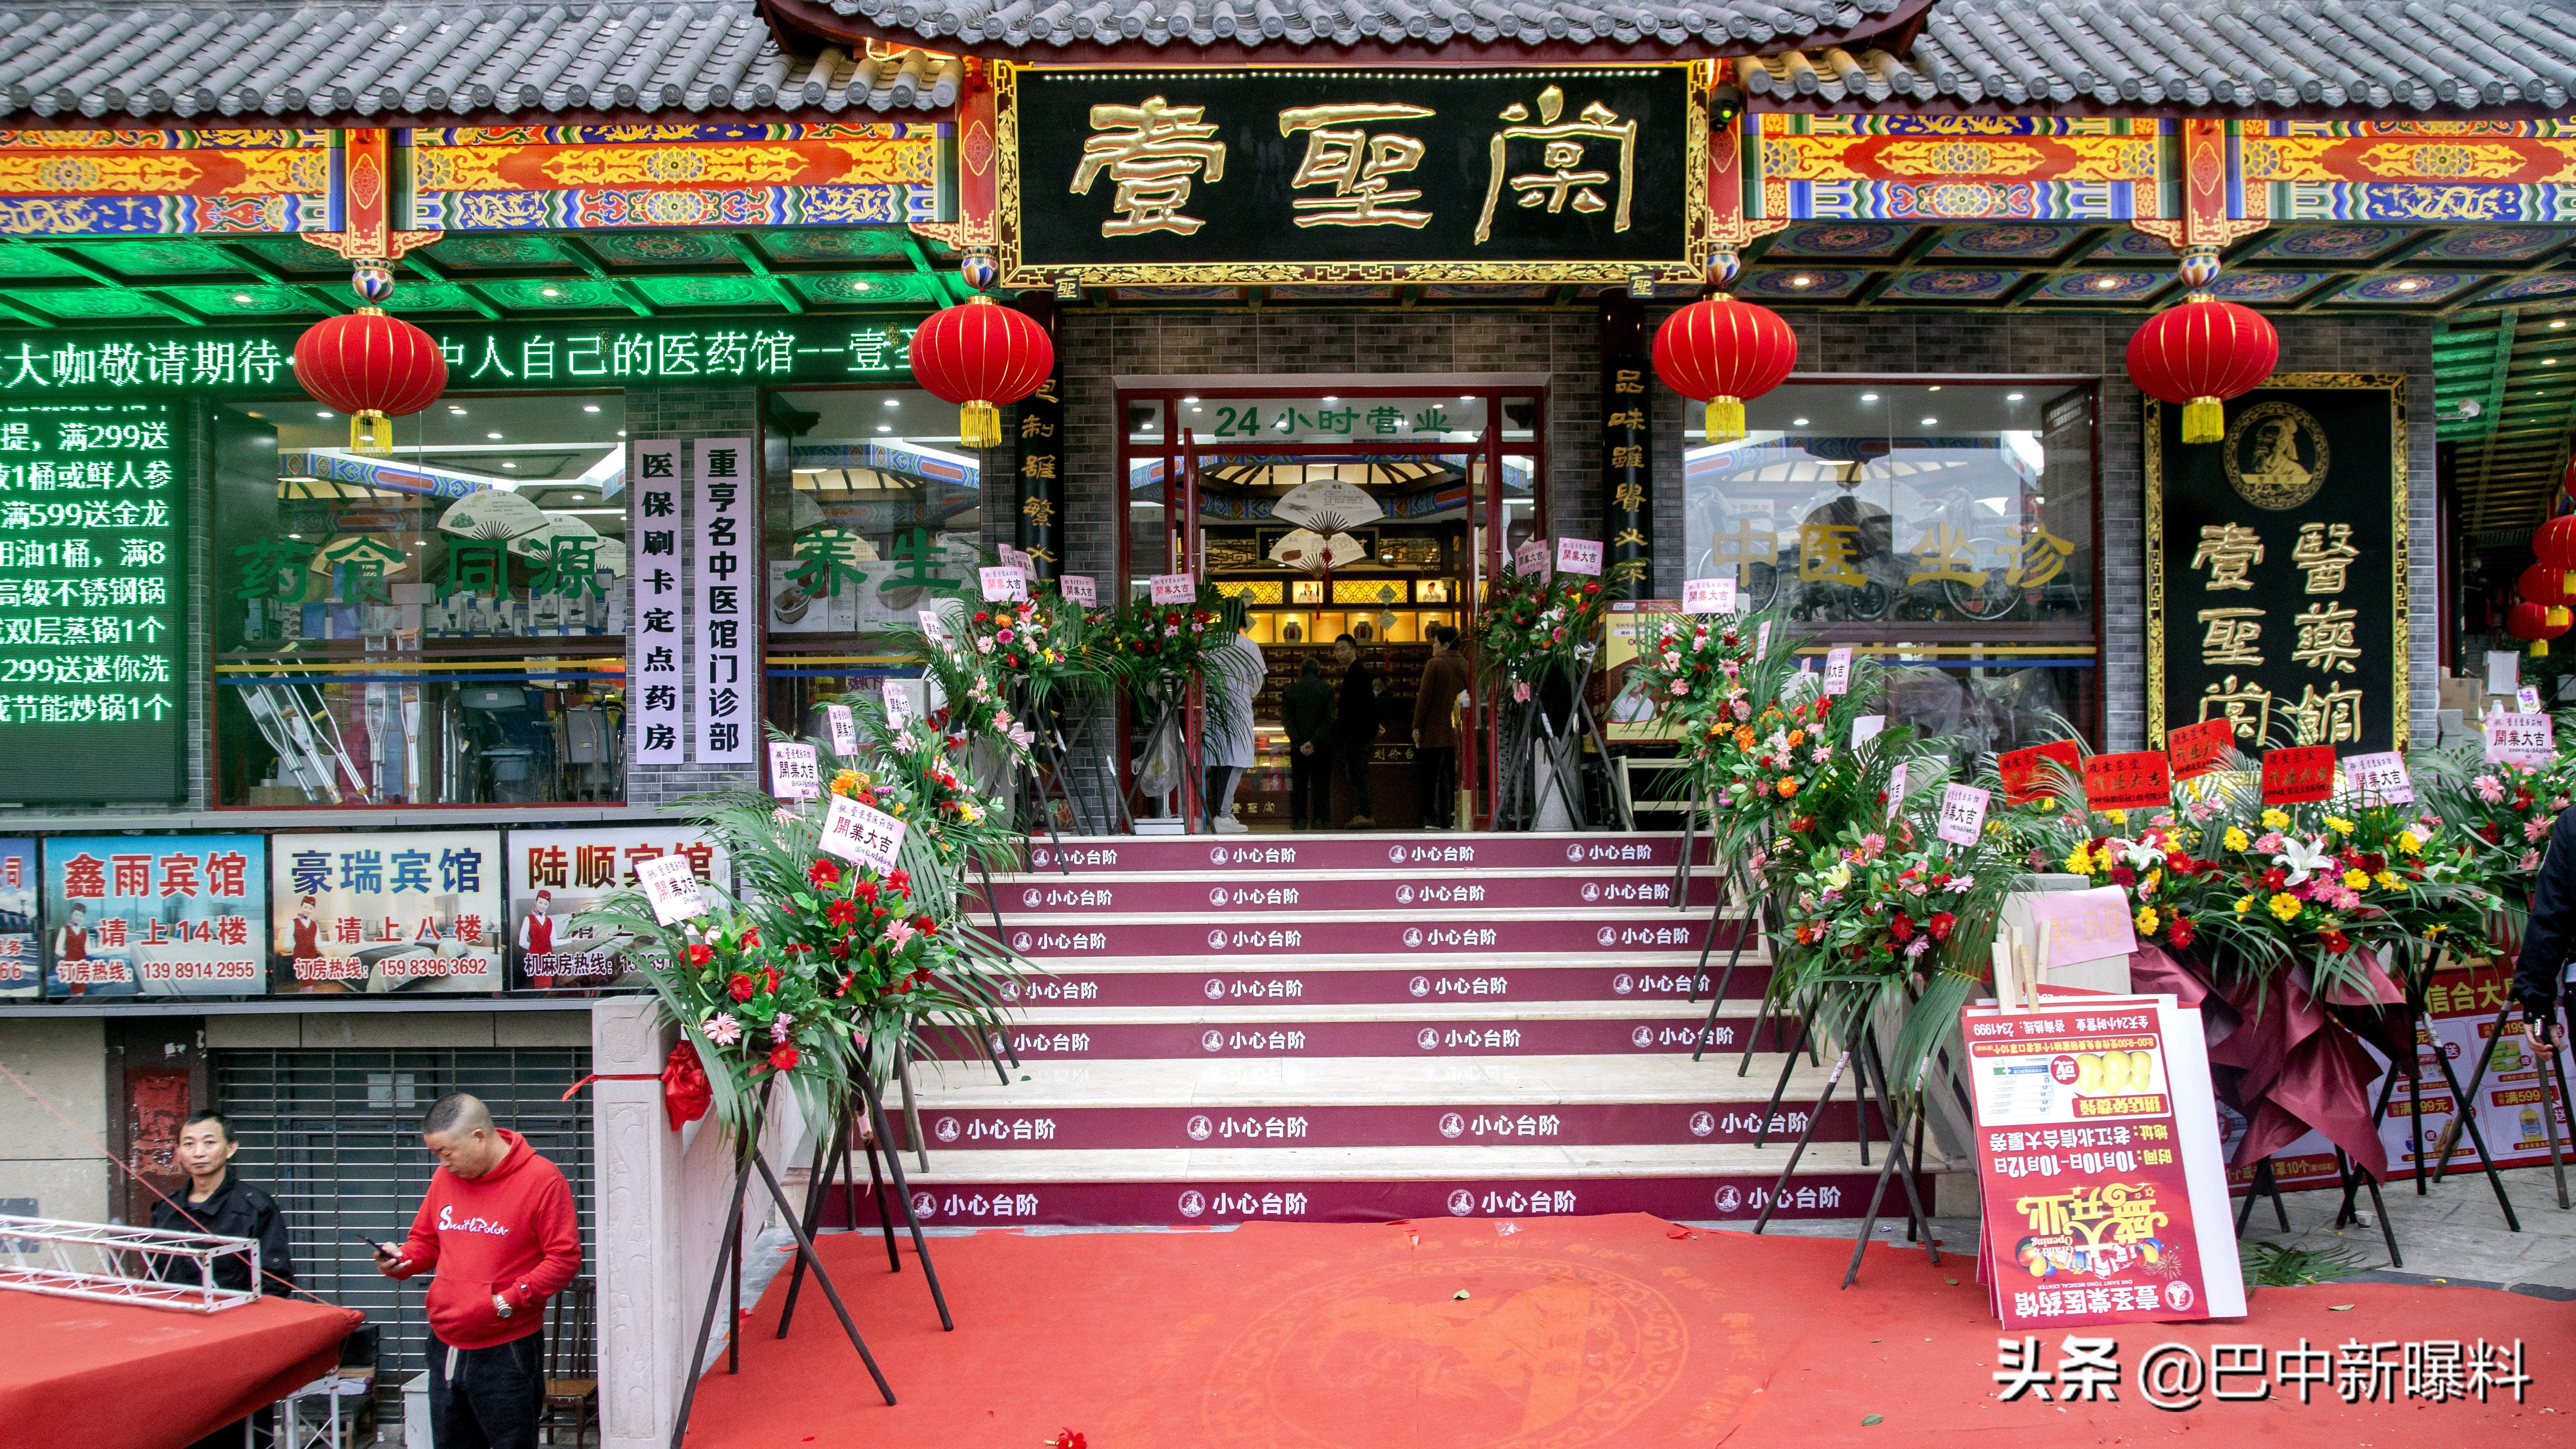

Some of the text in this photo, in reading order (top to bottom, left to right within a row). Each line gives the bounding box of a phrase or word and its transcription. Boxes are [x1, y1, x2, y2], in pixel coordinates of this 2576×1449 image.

[1, 500, 170, 530] 满599送金龙
[784, 526, 963, 597] 养生
[1712, 518, 2076, 589] 中医坐诊
[642, 452, 677, 751] 医保刷卡定点药房
[707, 448, 740, 752] 重亨名中医馆门诊部
[0, 615, 166, 645] 双层蒸锅1个
[2493, 730, 2545, 746] 開業大吉
[779, 761, 814, 779] 開業大吉
[833, 816, 893, 854] 開業大吉
[1054, 850, 1117, 864] 小心台阶
[1233, 848, 1296, 862] 小心台阶
[1412, 846, 1474, 861] 小心台阶
[1589, 845, 1651, 859] 小心台阶
[0, 856, 22, 890] 司
[64, 852, 247, 899] 鑫雨宾馆
[292, 848, 482, 896] 豪瑞宾馆
[656, 874, 696, 904] 開業大吉
[1047, 890, 1112, 905] 小心台阶
[1233, 888, 1299, 904] 小心台阶
[1420, 886, 1485, 901] 小心台阶
[1605, 884, 1669, 899] 小心台阶
[335, 914, 483, 945] 请上八楼
[1233, 930, 1302, 947] 小心台阶
[1428, 929, 1496, 945] 小心台阶
[1622, 928, 1689, 944] 小心台阶
[1037, 933, 1106, 949] 小心台阶
[143, 963, 170, 980] 139
[175, 962, 212, 979] 8914
[216, 960, 255, 979] 2955
[379, 958, 406, 977] 159
[410, 957, 447, 977] 8396
[450, 957, 487, 976] 3692
[1026, 982, 1098, 999] 小心台阶
[1230, 980, 1302, 997] 小心台阶
[1435, 977, 1507, 994] 小心台阶
[1639, 975, 1709, 991] 小心台阶
[2076, 1015, 2149, 1032] 全天24小时营业
[1014, 1033, 1090, 1051] 小心台阶
[1229, 1031, 1305, 1049] 小心台阶
[1445, 1029, 1521, 1047] 小心台阶
[1659, 1027, 1733, 1045] 小心台阶
[2054, 1060, 2077, 1080] 或
[2080, 1096, 2161, 1116] 进店免费领
[967, 1119, 1055, 1139] 小心台阶
[1219, 1117, 1308, 1137] 小心台阶
[1471, 1115, 1559, 1135] 小心台阶
[1721, 1112, 1808, 1133] 小心台阶
[944, 1194, 1038, 1215] 小心台阶
[1213, 1193, 1307, 1214] 小心台阶
[1482, 1191, 1576, 1212] 小心台阶
[1749, 1187, 1840, 1208] 小心台阶
[2014, 1285, 2161, 1319] 壹圣棠医药馆
